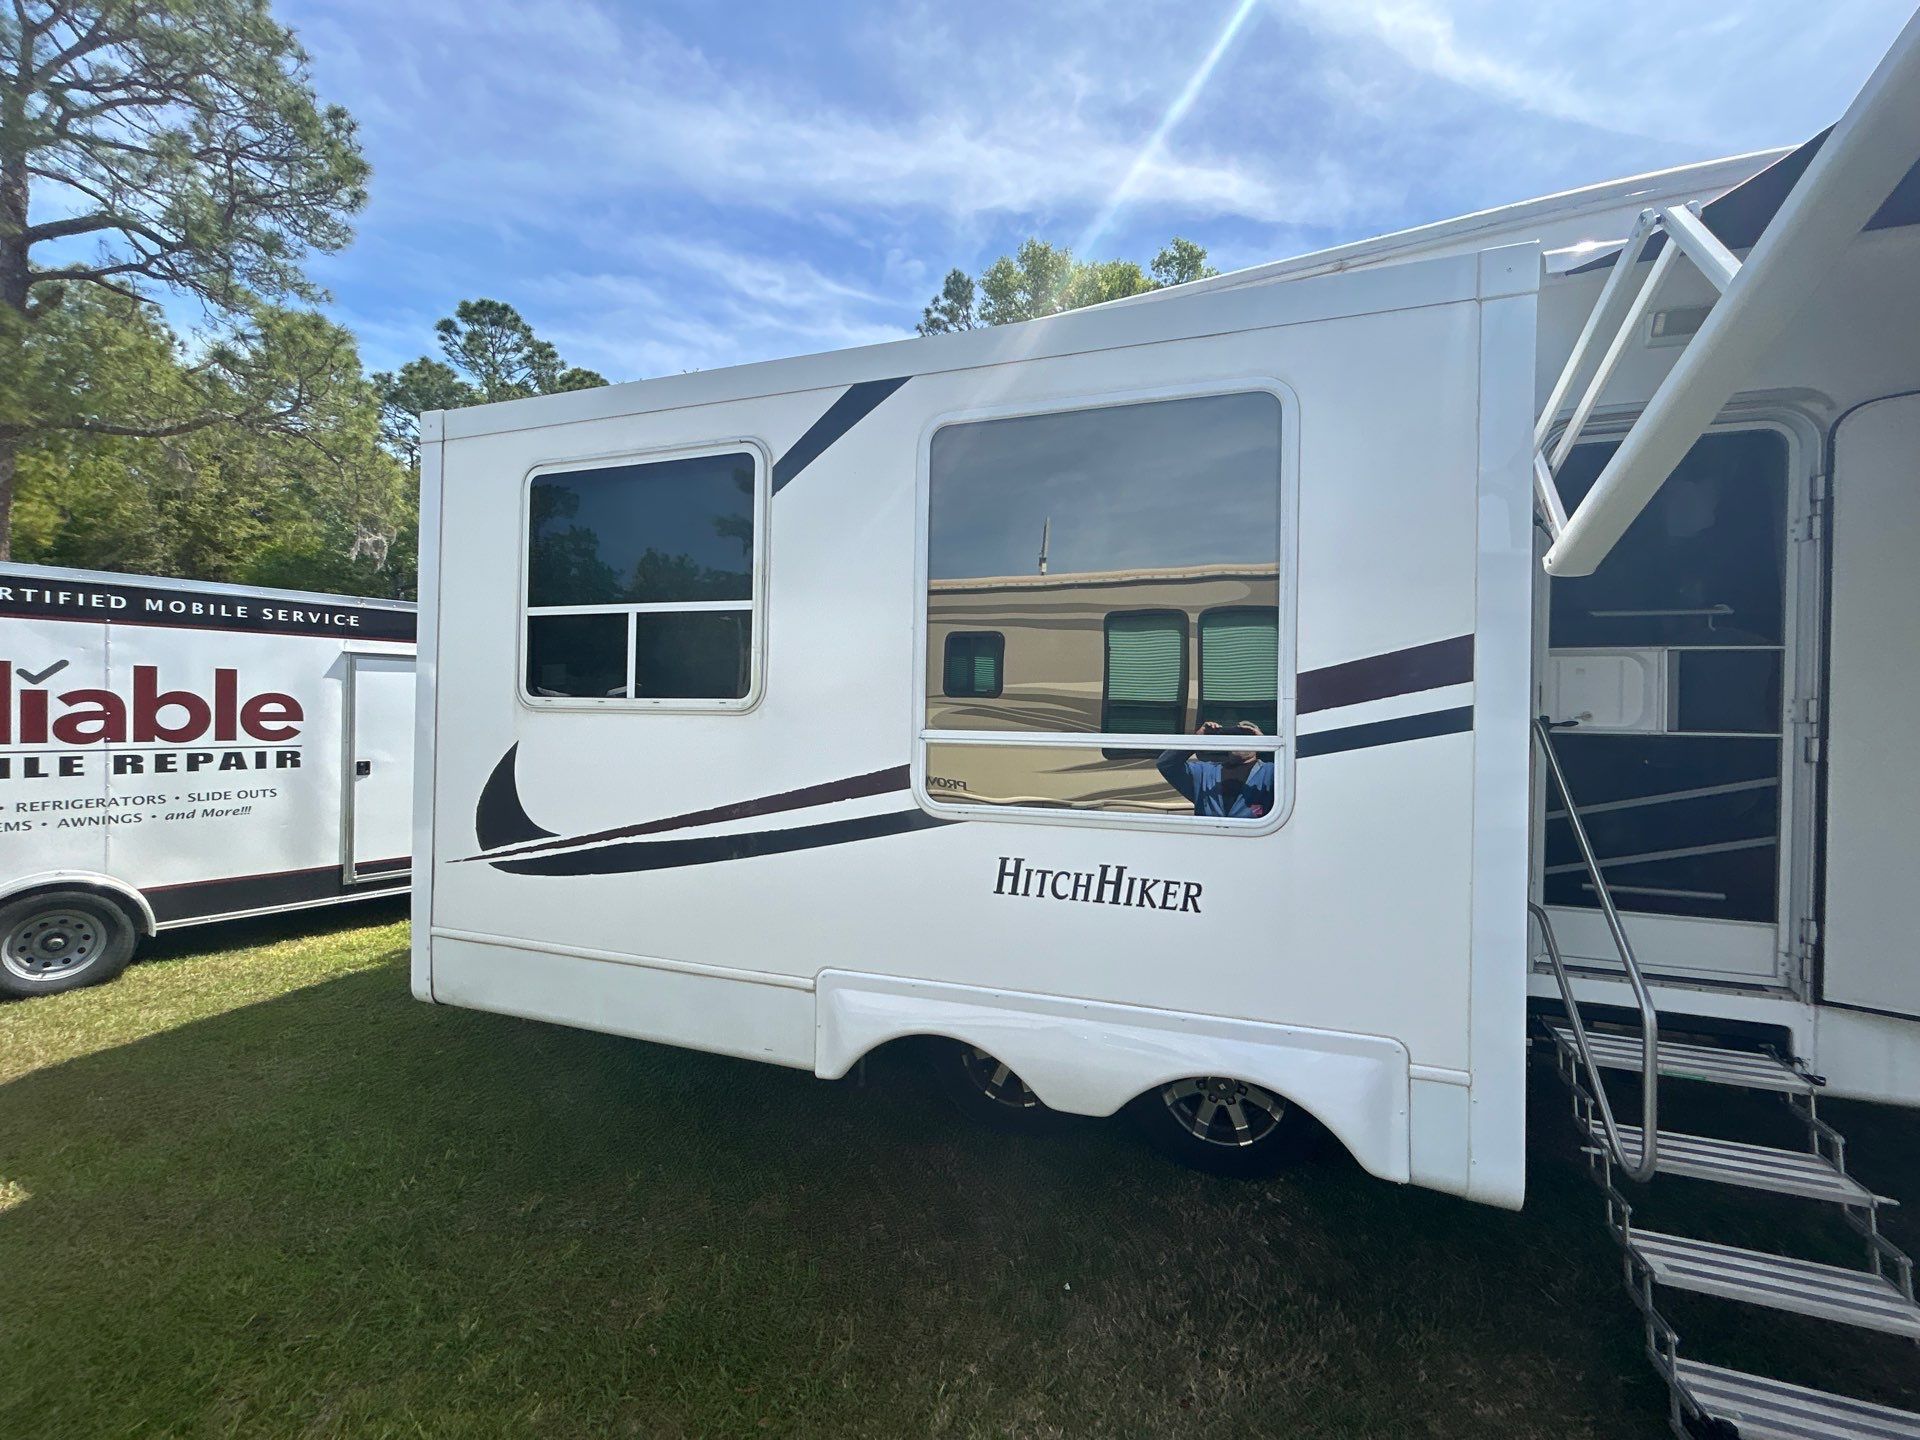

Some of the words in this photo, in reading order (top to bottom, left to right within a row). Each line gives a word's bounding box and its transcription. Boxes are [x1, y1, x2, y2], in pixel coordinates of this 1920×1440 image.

[0, 586, 127, 609] RTIFIED
[145, 598, 248, 618] MOBILE
[262, 608, 360, 627] SERVICE
[113, 750, 301, 775] REPAIR
[16, 794, 167, 813] REFRIGERATORS
[187, 791, 232, 803] SLIDE
[236, 788, 278, 800] OUTS
[57, 812, 143, 829] AWNINGS
[164, 809, 197, 821] and
[201, 805, 252, 818] More!!!
